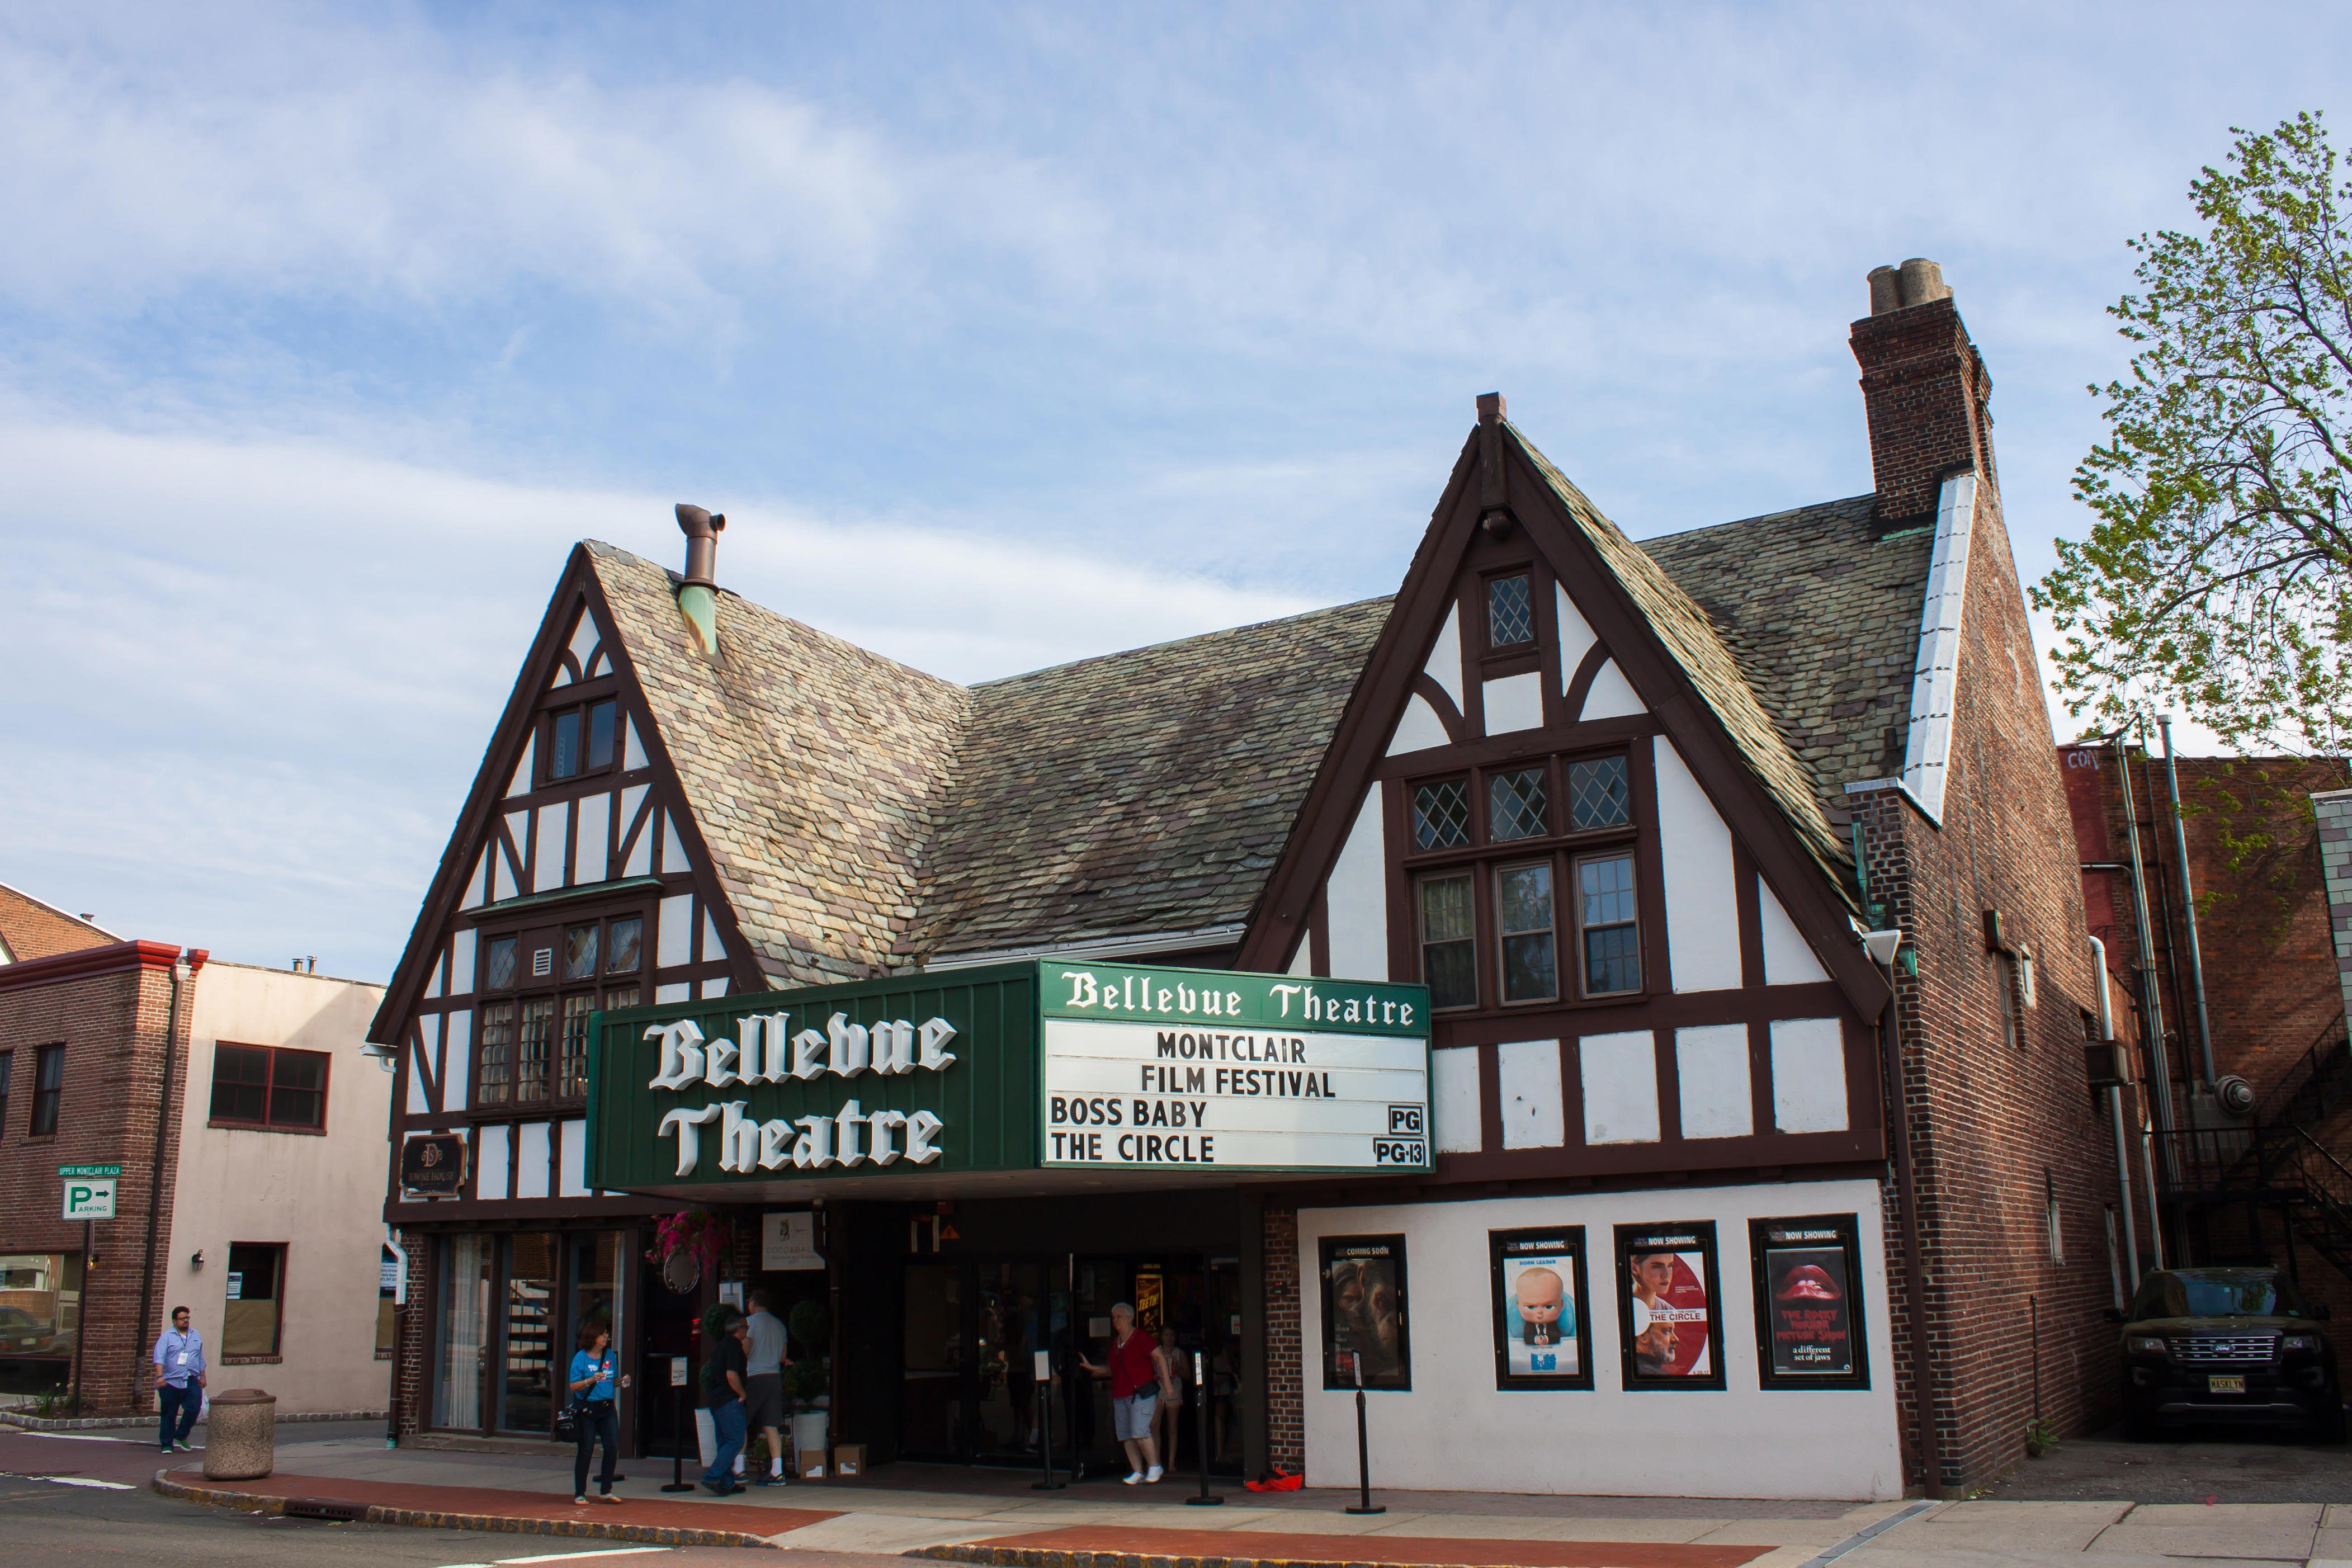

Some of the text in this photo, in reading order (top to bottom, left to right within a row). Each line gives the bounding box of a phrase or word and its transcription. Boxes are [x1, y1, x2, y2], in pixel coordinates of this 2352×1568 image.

[1061, 971, 1414, 1026] Bellevue Theatre
[643, 1011, 957, 1090] Bellevue
[1157, 1032, 1307, 1064] MONTCLAIR
[1141, 1065, 1336, 1098] FILM FESTIVAL
[1051, 1097, 1207, 1128] BOSS BABY
[1391, 1110, 1420, 1130] PG
[658, 1099, 943, 1177] Theatre
[1051, 1132, 1214, 1163] THE CIRCLE
[1377, 1142, 1423, 1163] PG-13
[432, 1172, 454, 1181] HOUSE
[1536, 1240, 1564, 1249] SHOWING
[1648, 1237, 1664, 1245] NOW
[1665, 1235, 1695, 1245] SHOWING
[1785, 1231, 1802, 1240] NOW
[1803, 1230, 1836, 1239] SHOWING
[1781, 1310, 1838, 1321] THE ROCKY
[1798, 1345, 1831, 1354] different
[1815, 1353, 1831, 1363] jaws
